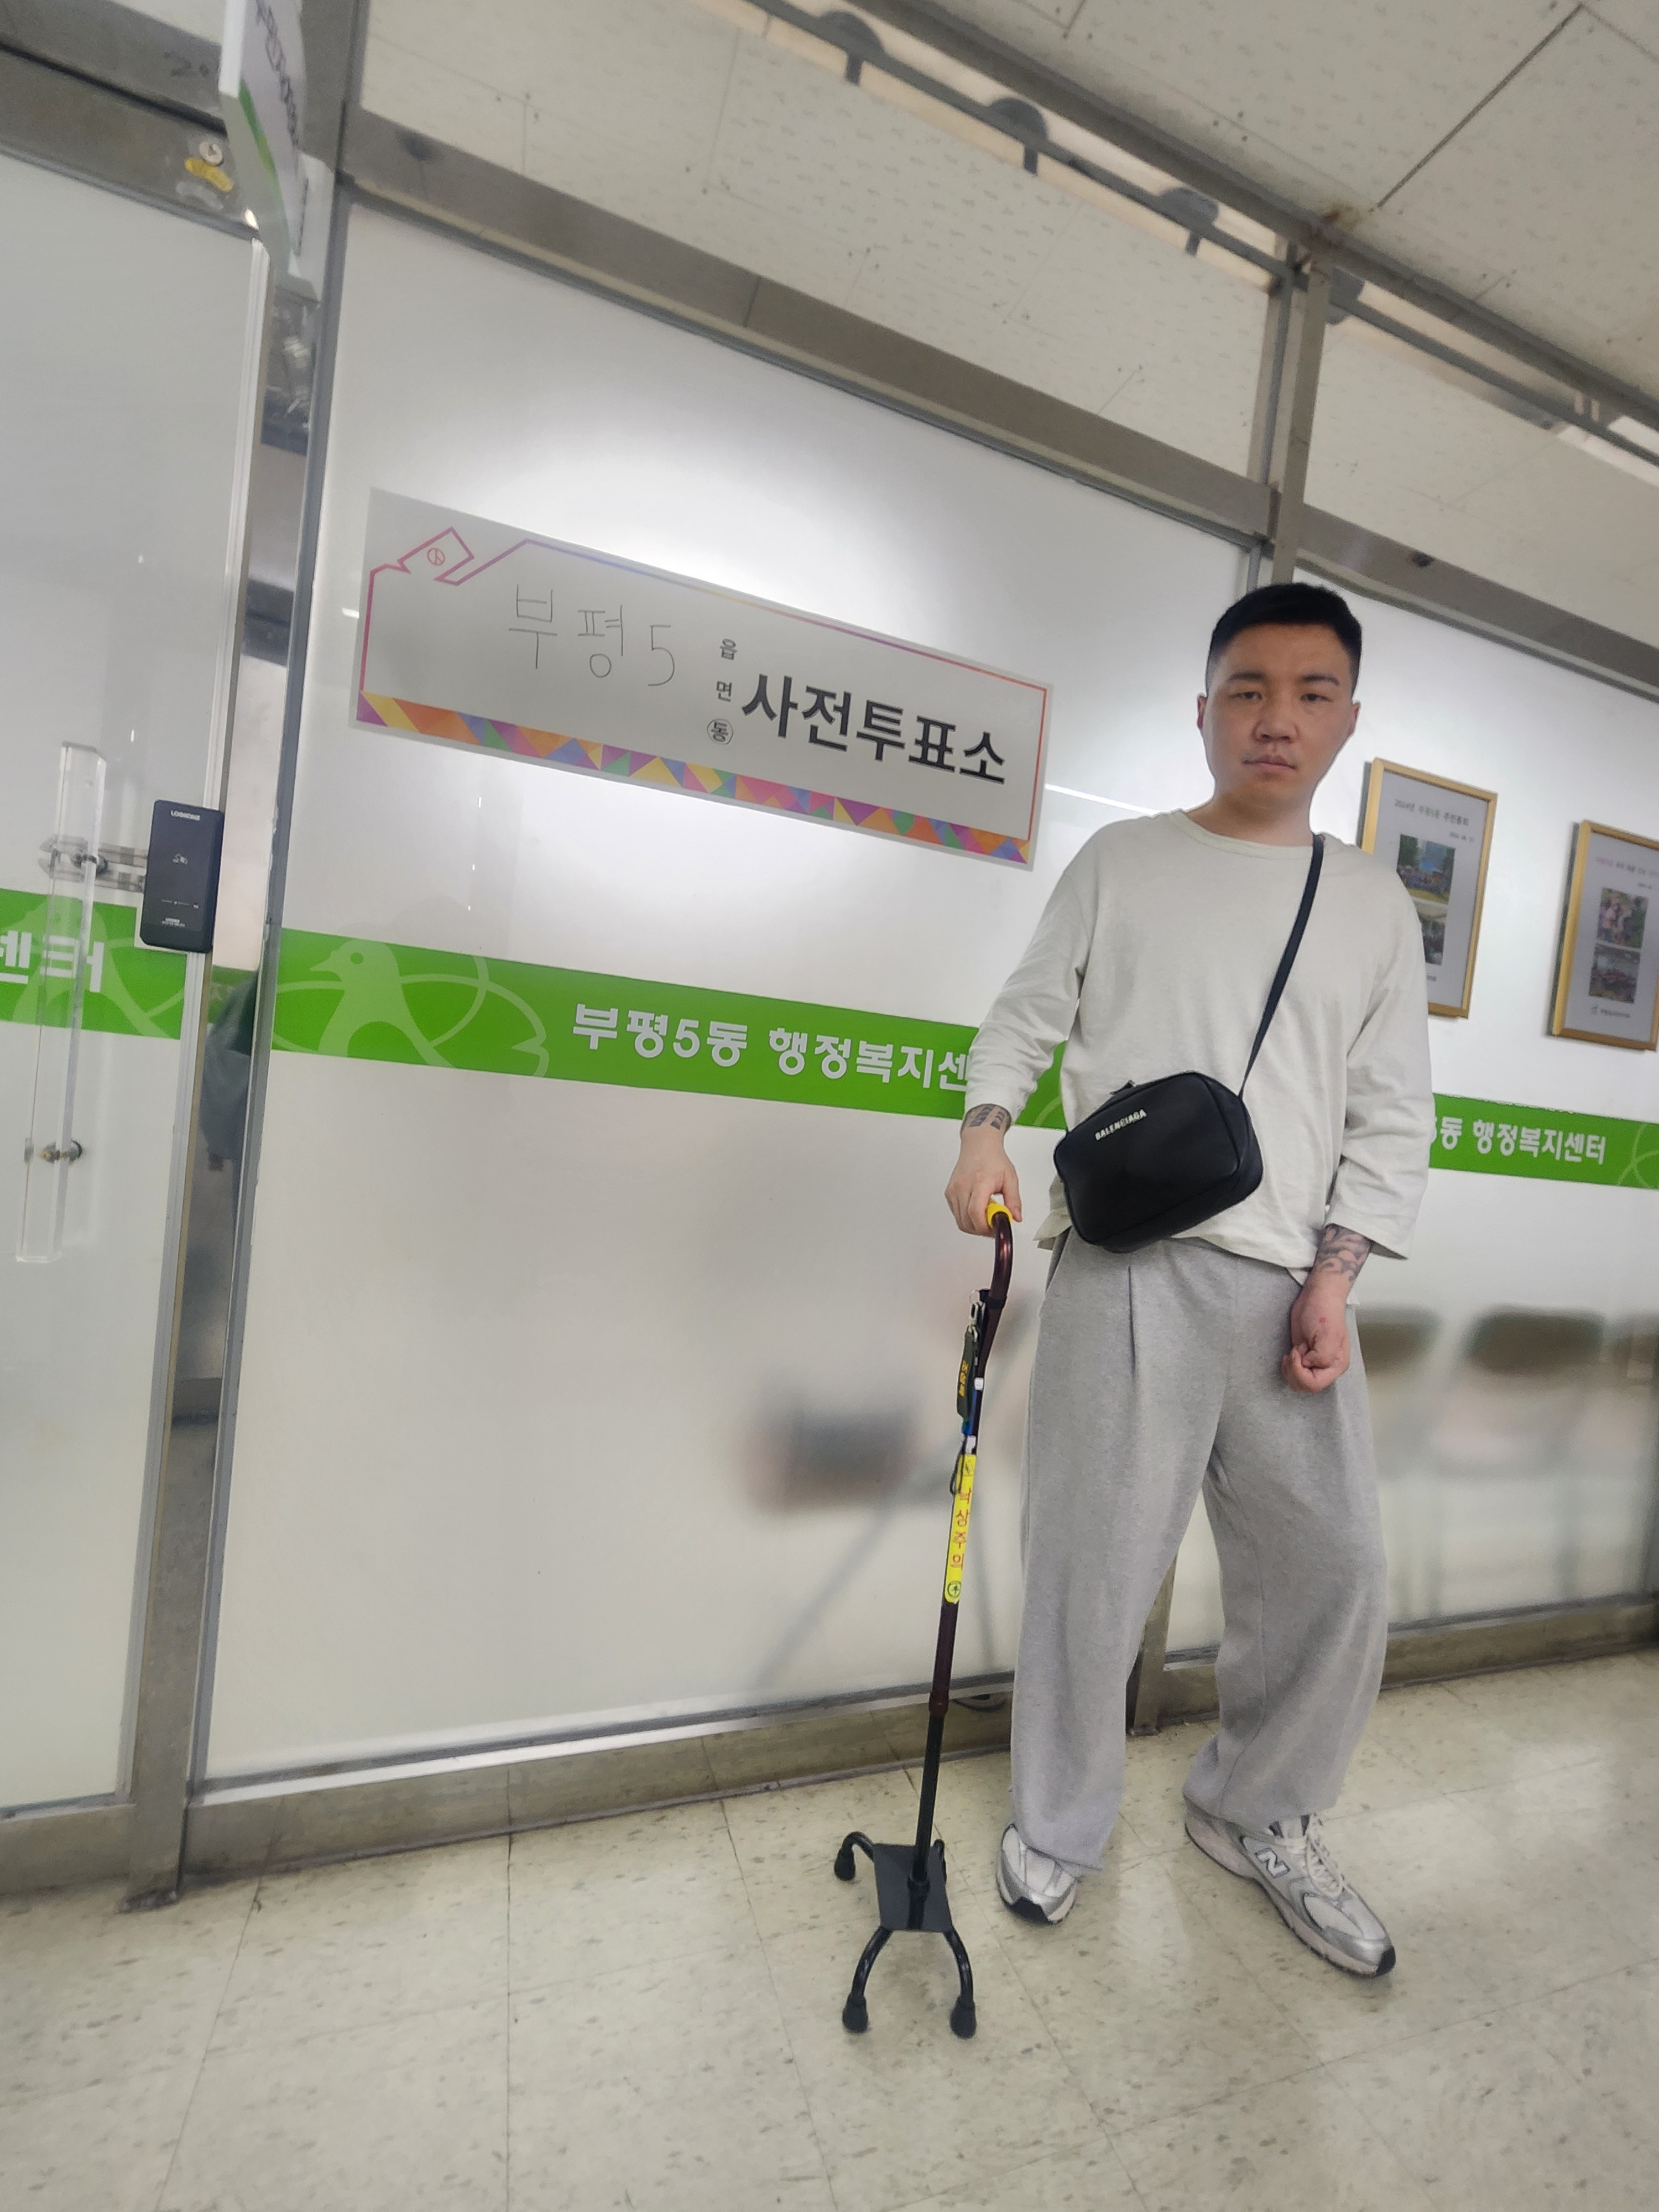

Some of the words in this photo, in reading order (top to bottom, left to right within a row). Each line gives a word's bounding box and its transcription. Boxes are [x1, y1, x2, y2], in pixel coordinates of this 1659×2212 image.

[719, 638, 737, 661] 읍
[716, 681, 732, 702] 면
[741, 674, 1005, 785] 사전투표소
[572, 1003, 748, 1068] 부평5동
[1095, 1108, 1147, 1141] BALENCIAGA
[1473, 1118, 1605, 1165] 행정복지센터
